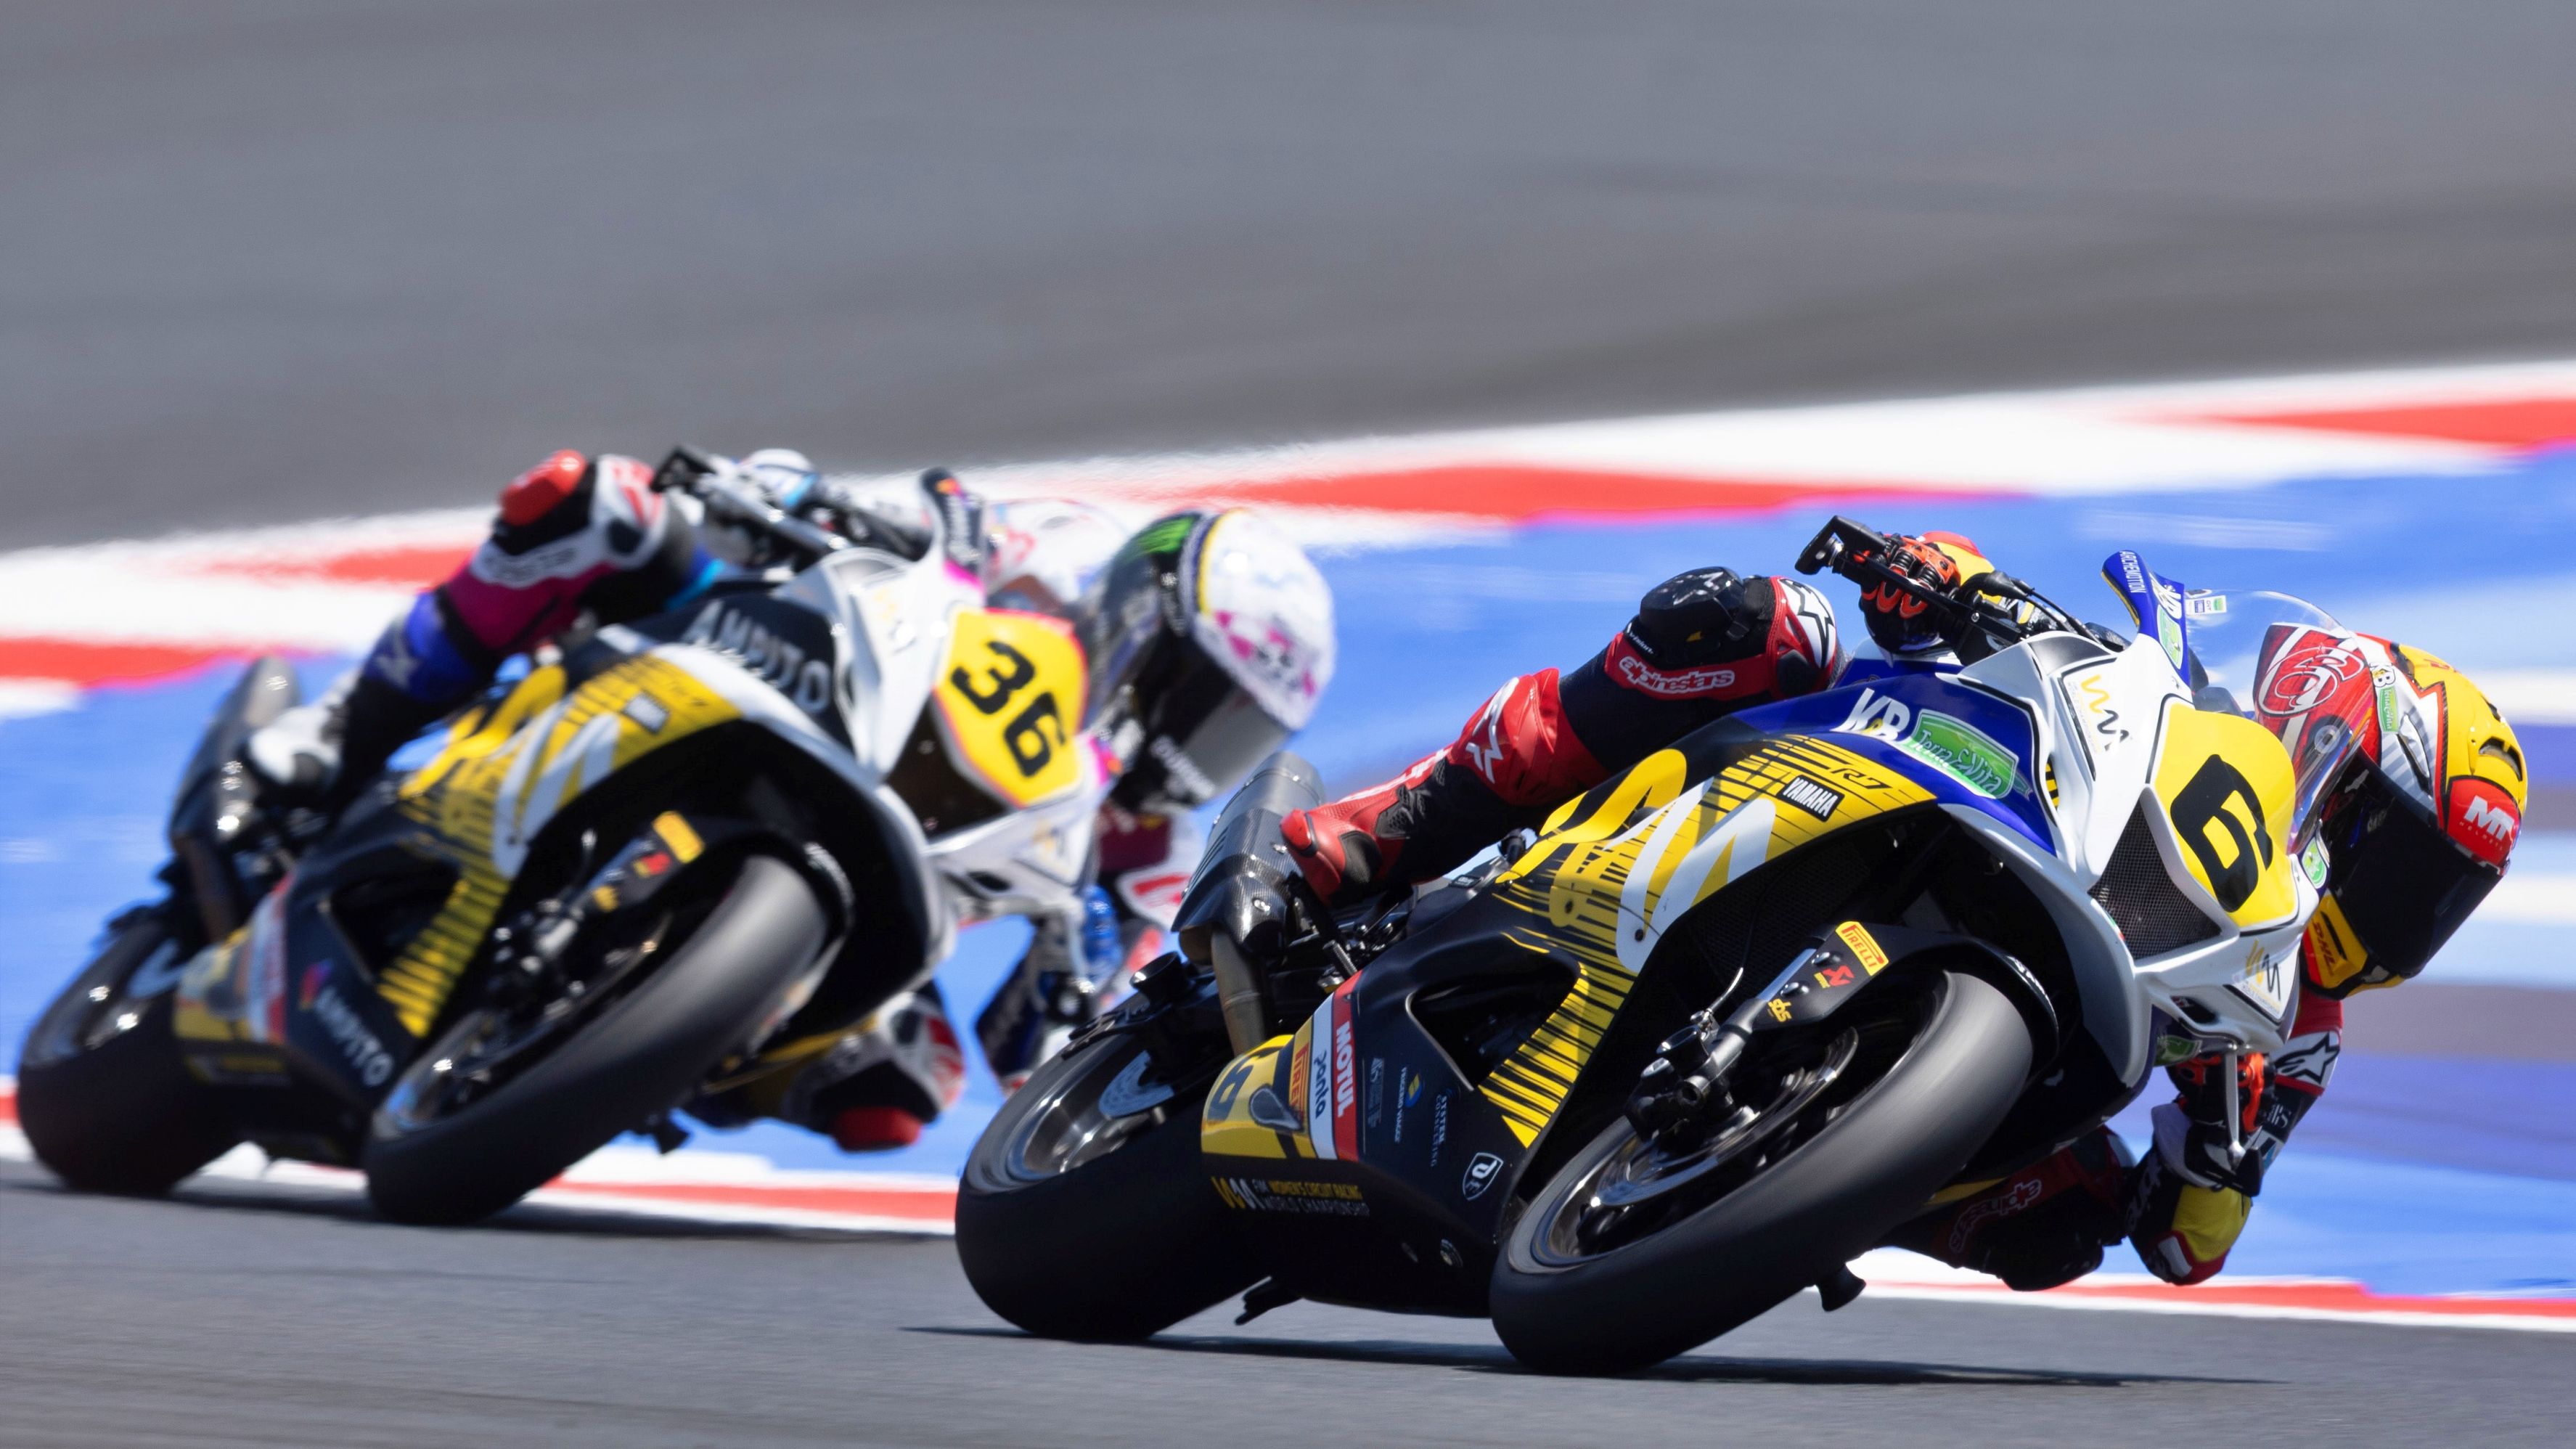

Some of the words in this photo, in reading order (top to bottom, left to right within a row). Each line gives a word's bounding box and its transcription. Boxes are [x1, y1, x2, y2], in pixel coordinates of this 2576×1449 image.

[952, 640, 1065, 777] 36
[1783, 777, 1839, 817] YAMAHA
[2170, 754, 2273, 913] 6
[1841, 924, 1884, 968] PIRELLI
[1336, 1021, 1354, 1118] MOTUL
[1439, 1094, 1447, 1144] SYSTEM
